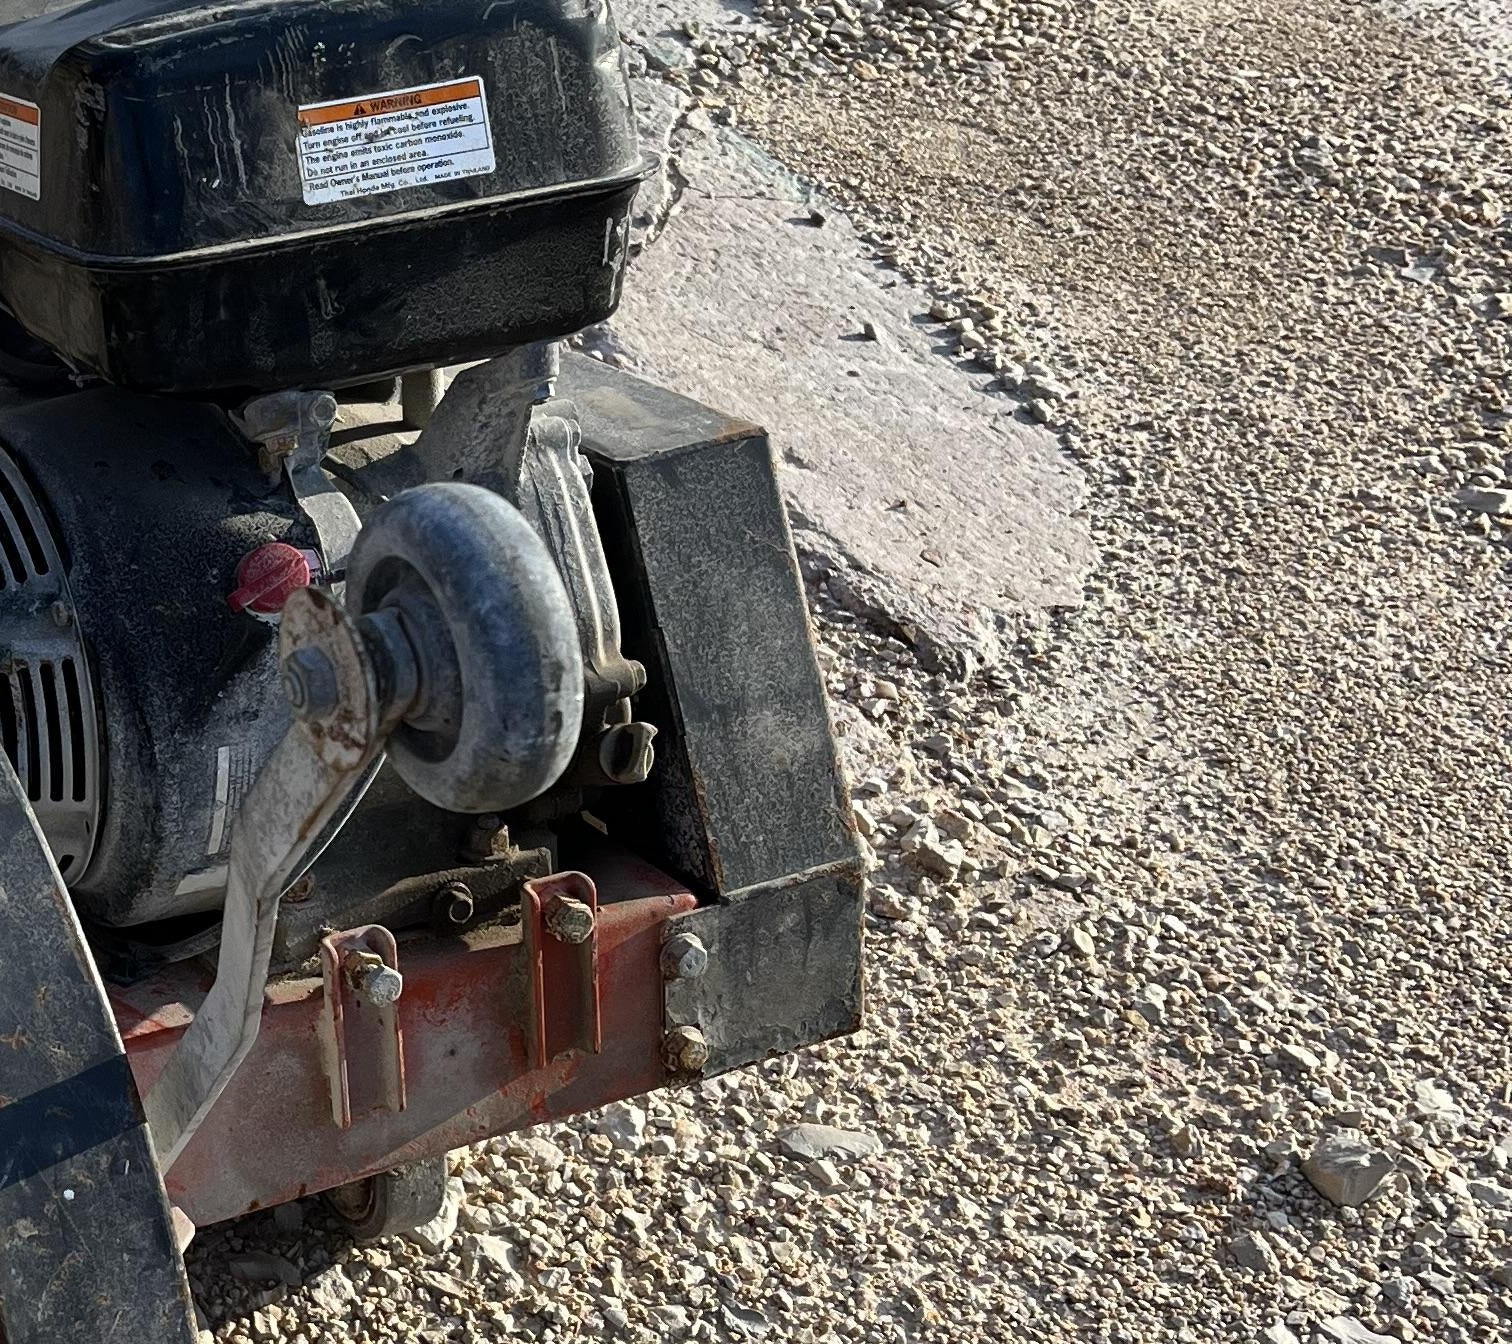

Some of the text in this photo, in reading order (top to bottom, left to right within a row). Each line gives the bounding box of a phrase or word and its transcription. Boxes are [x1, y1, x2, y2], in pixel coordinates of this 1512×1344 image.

[369, 94, 422, 112] WARNING
[302, 103, 470, 138] Gasoline is highly flammable and explosive.
[303, 141, 321, 151] Turn
[323, 136, 349, 147] engine
[351, 132, 362, 142] off
[411, 120, 437, 132] before
[305, 130, 465, 165] The engine emits toxic carbon monoxide.
[306, 167, 319, 177] Do
[320, 166, 334, 175] not
[335, 164, 349, 172] run
[350, 161, 358, 170] in
[360, 160, 370, 168] an
[372, 152, 407, 166] enclosed
[309, 159, 454, 191] Read Owner's Manual before operation.
[340, 188, 355, 197] Thai
[357, 184, 380, 195] Honda
[434, 172, 452, 180] MADE
